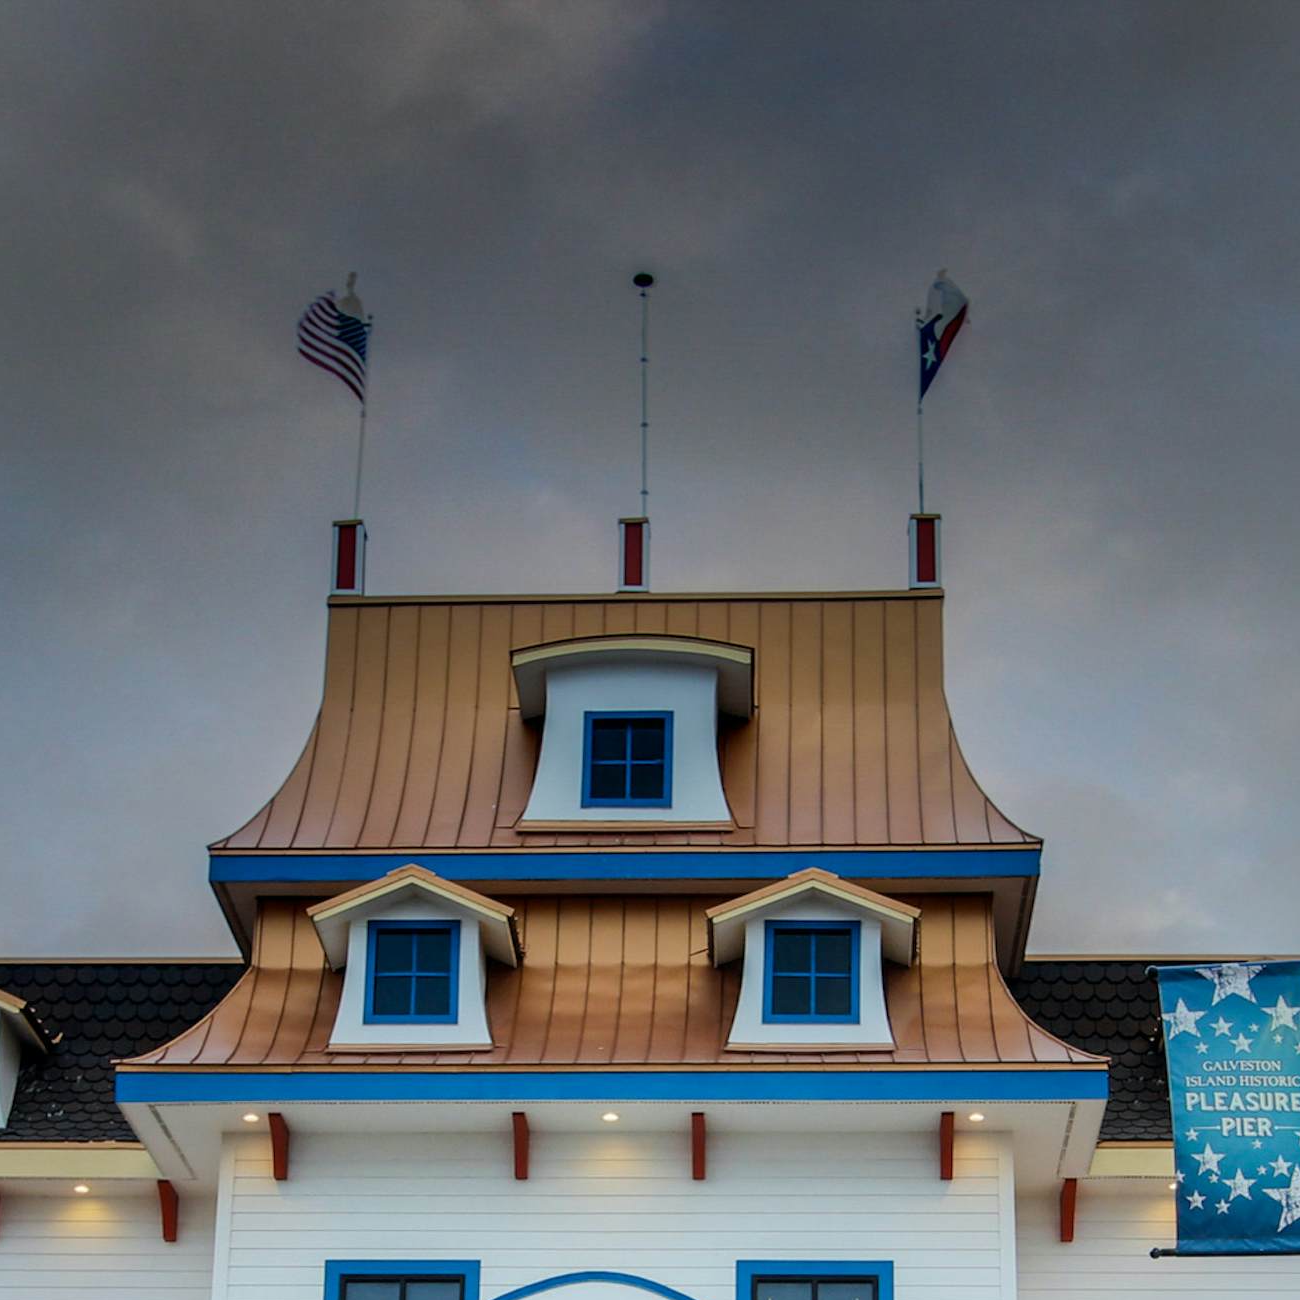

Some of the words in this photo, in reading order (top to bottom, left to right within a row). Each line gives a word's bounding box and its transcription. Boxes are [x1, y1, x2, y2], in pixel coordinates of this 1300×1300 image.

[1201, 1059, 1282, 1073] GALVESTON
[1185, 1075, 1237, 1088] ISLAND
[1220, 1117, 1274, 1138] PIER
